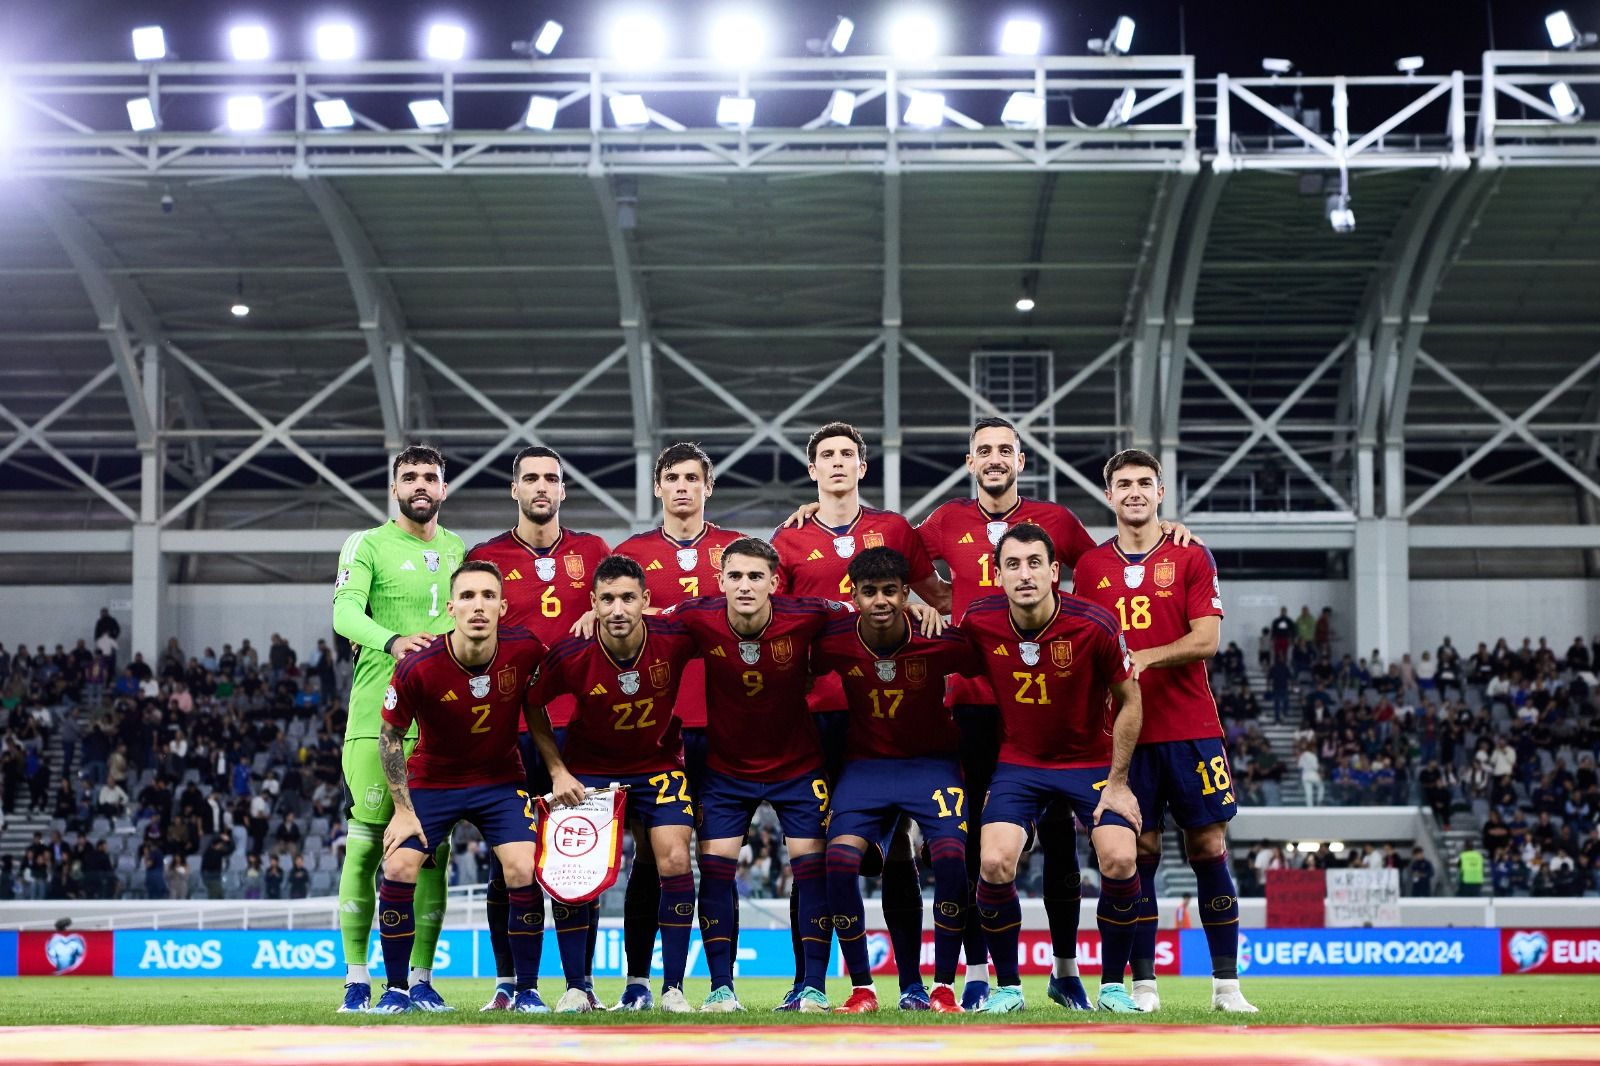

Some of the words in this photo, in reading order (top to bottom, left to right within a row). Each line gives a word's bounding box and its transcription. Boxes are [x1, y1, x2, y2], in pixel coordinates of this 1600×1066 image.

[977, 553, 998, 587] 1
[428, 583, 440, 617] 1
[541, 585, 562, 618] 6
[1115, 595, 1152, 631] 18
[742, 670, 764, 697] 9
[1012, 671, 1052, 705] 21
[470, 703, 491, 734] 2
[612, 698, 656, 731] 22
[868, 688, 905, 719] 17
[648, 770, 692, 804] 22
[1195, 755, 1230, 796] 18
[811, 779, 830, 812] 9
[931, 787, 965, 818] 17
[368, 940, 451, 970] AS
[1552, 940, 1600, 964] EUR
